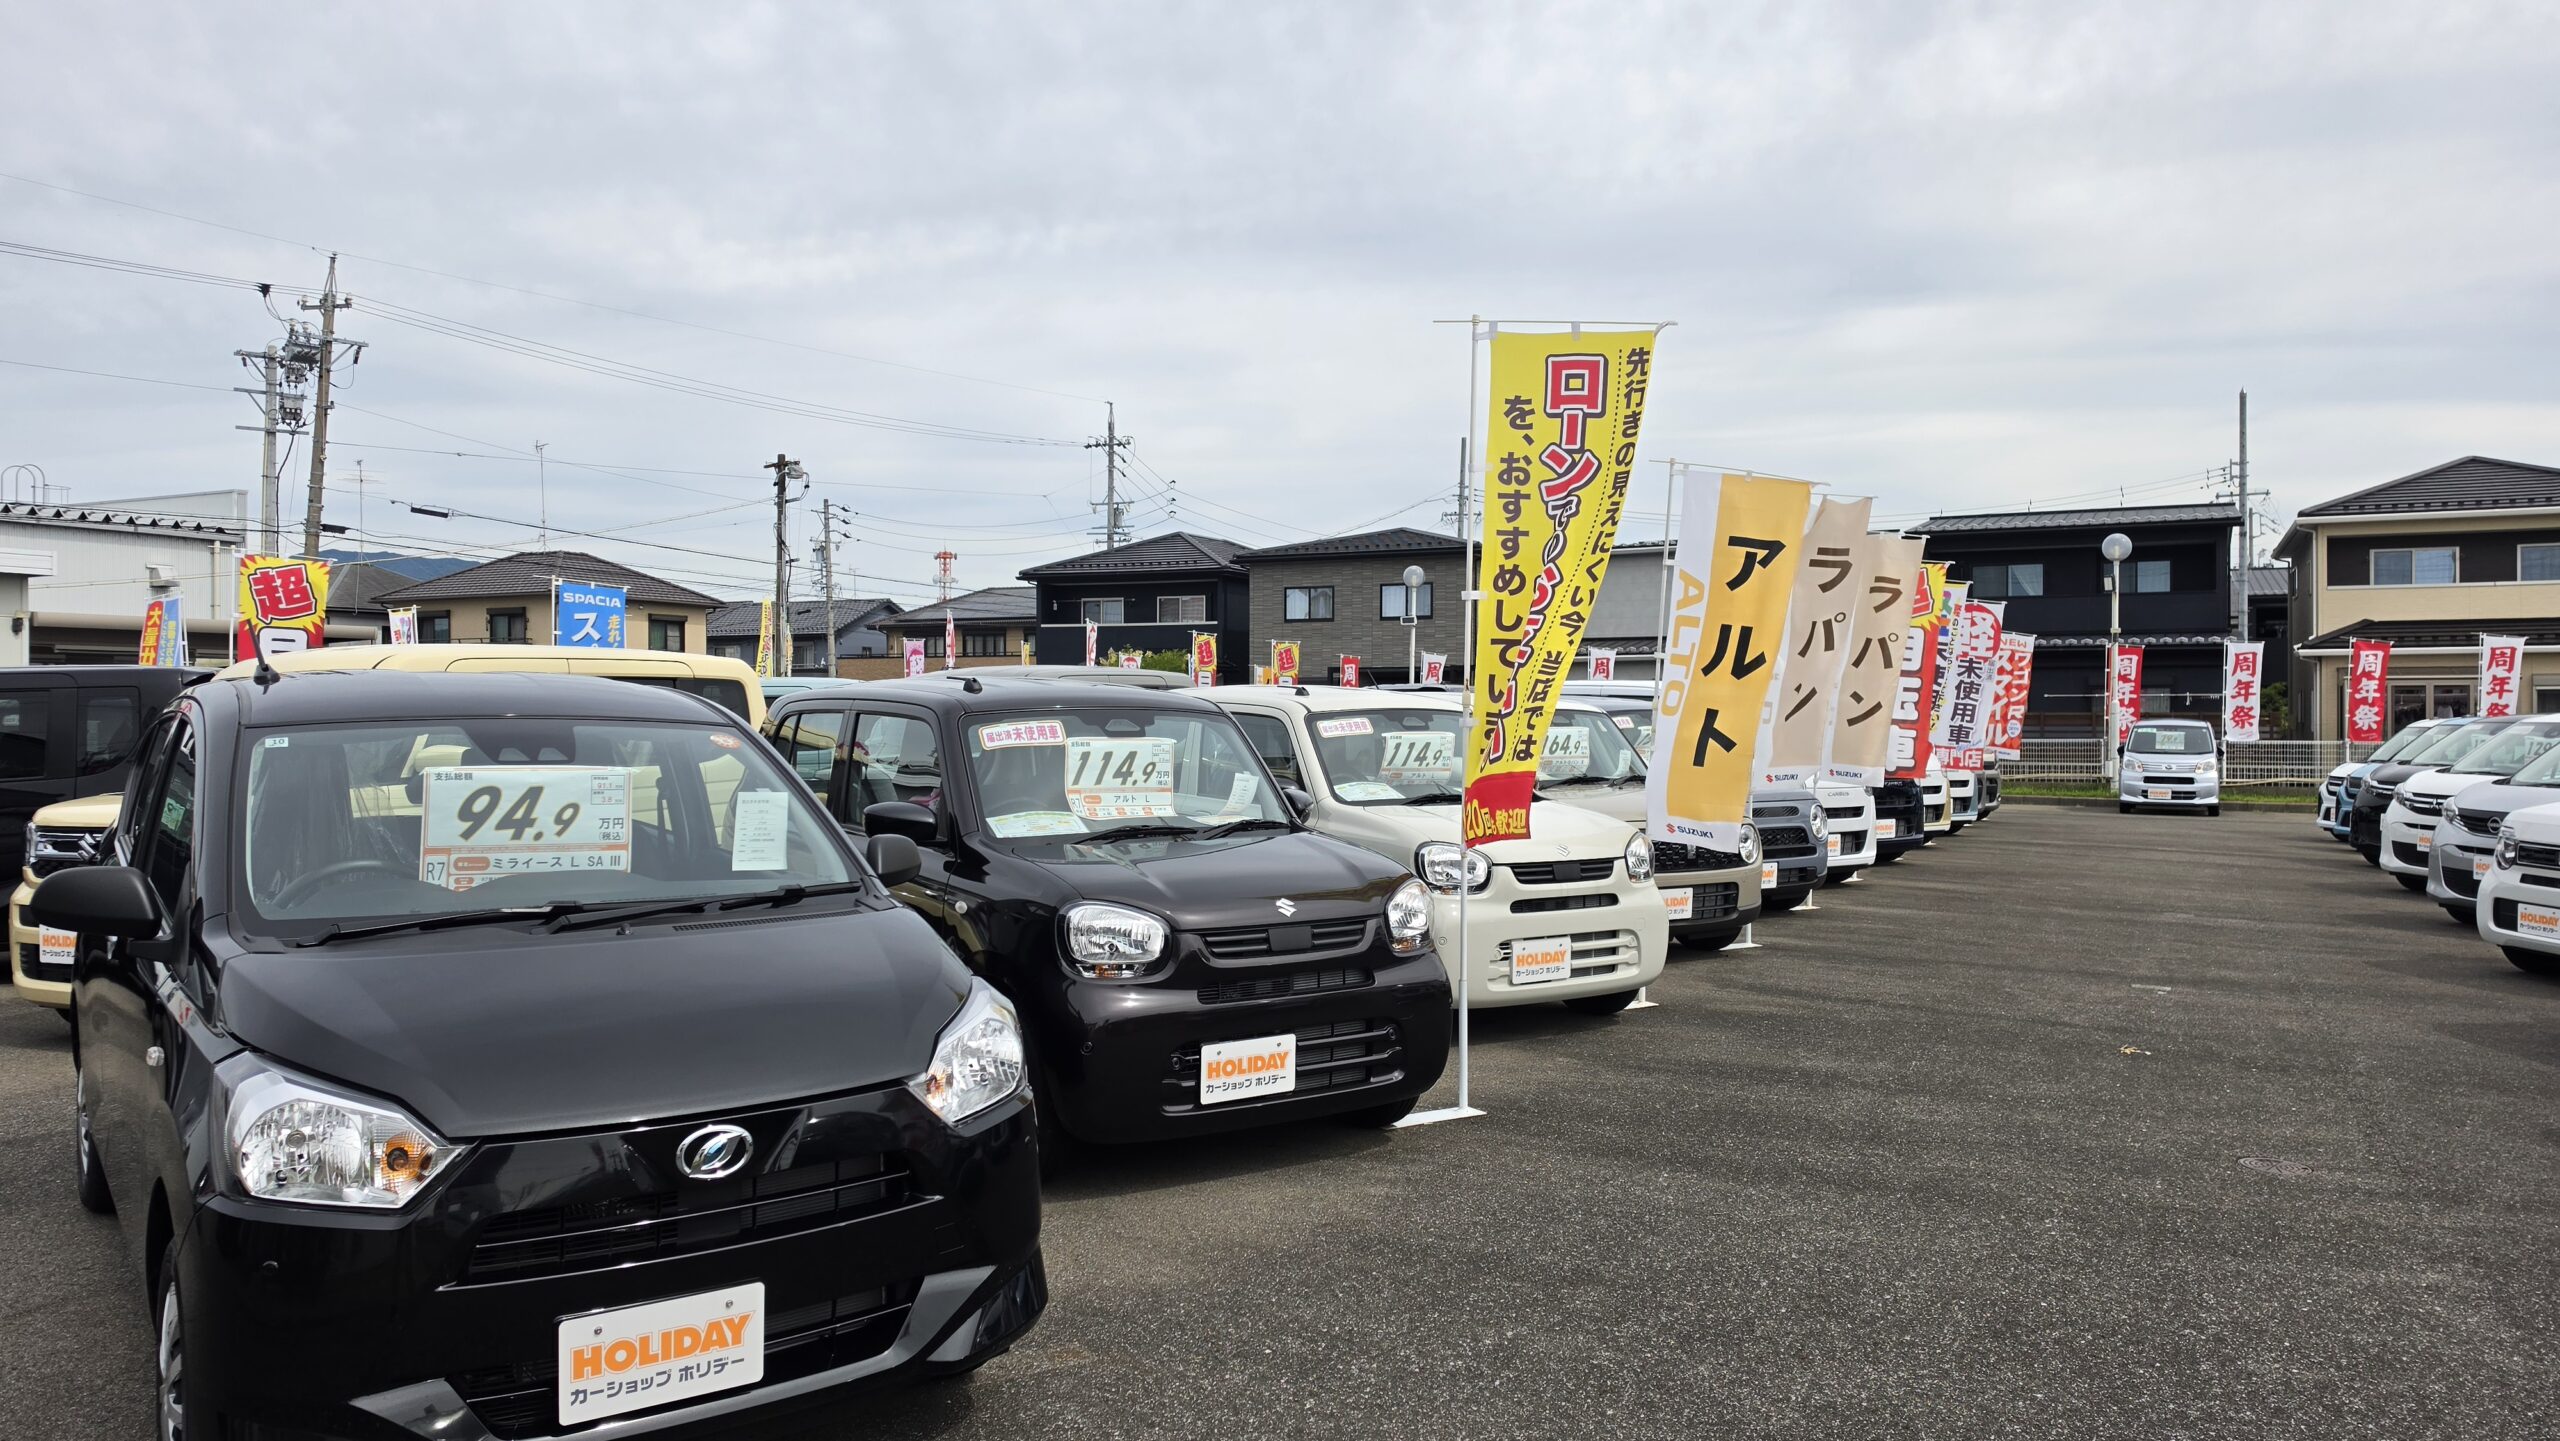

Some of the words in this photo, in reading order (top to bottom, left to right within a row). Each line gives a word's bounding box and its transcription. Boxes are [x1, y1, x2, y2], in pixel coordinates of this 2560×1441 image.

[562, 592, 622, 608] SPACIA
[571, 612, 602, 648] ス
[1661, 568, 1706, 718] ALTO
[1784, 546, 1853, 724] ラパン
[1692, 535, 1787, 768] アルト
[1851, 575, 1904, 727] ラパン
[1593, 656, 1611, 680] 周
[1948, 657, 1984, 746] 未使用車
[1984, 650, 2013, 746] スマイル
[2230, 651, 2258, 730] 周年祭
[2352, 649, 2385, 731] 周年祭
[1071, 750, 1157, 786] 114.9
[1386, 741, 1443, 768] 114.9
[433, 771, 474, 782] 支払総額
[1836, 770, 1863, 779] SUZUKI
[457, 785, 581, 841] 94.9
[598, 817, 624, 830] 万円
[1677, 825, 1714, 839] SUZUKI
[426, 862, 446, 881] R7
[493, 856, 563, 869] ミライース
[571, 856, 580, 867] L
[587, 855, 604, 866] SA
[2519, 911, 2560, 927] HOLIDAY
[1516, 949, 1567, 968] HOLIDAY
[1206, 1051, 1289, 1080] HOLIDAY
[1205, 1076, 1253, 1094] カーショップ
[1255, 1074, 1287, 1087] ホリデー
[571, 1311, 755, 1383] HOLIDAY
[570, 1368, 673, 1407] カーショップ
[678, 1356, 745, 1383] ホリデー
